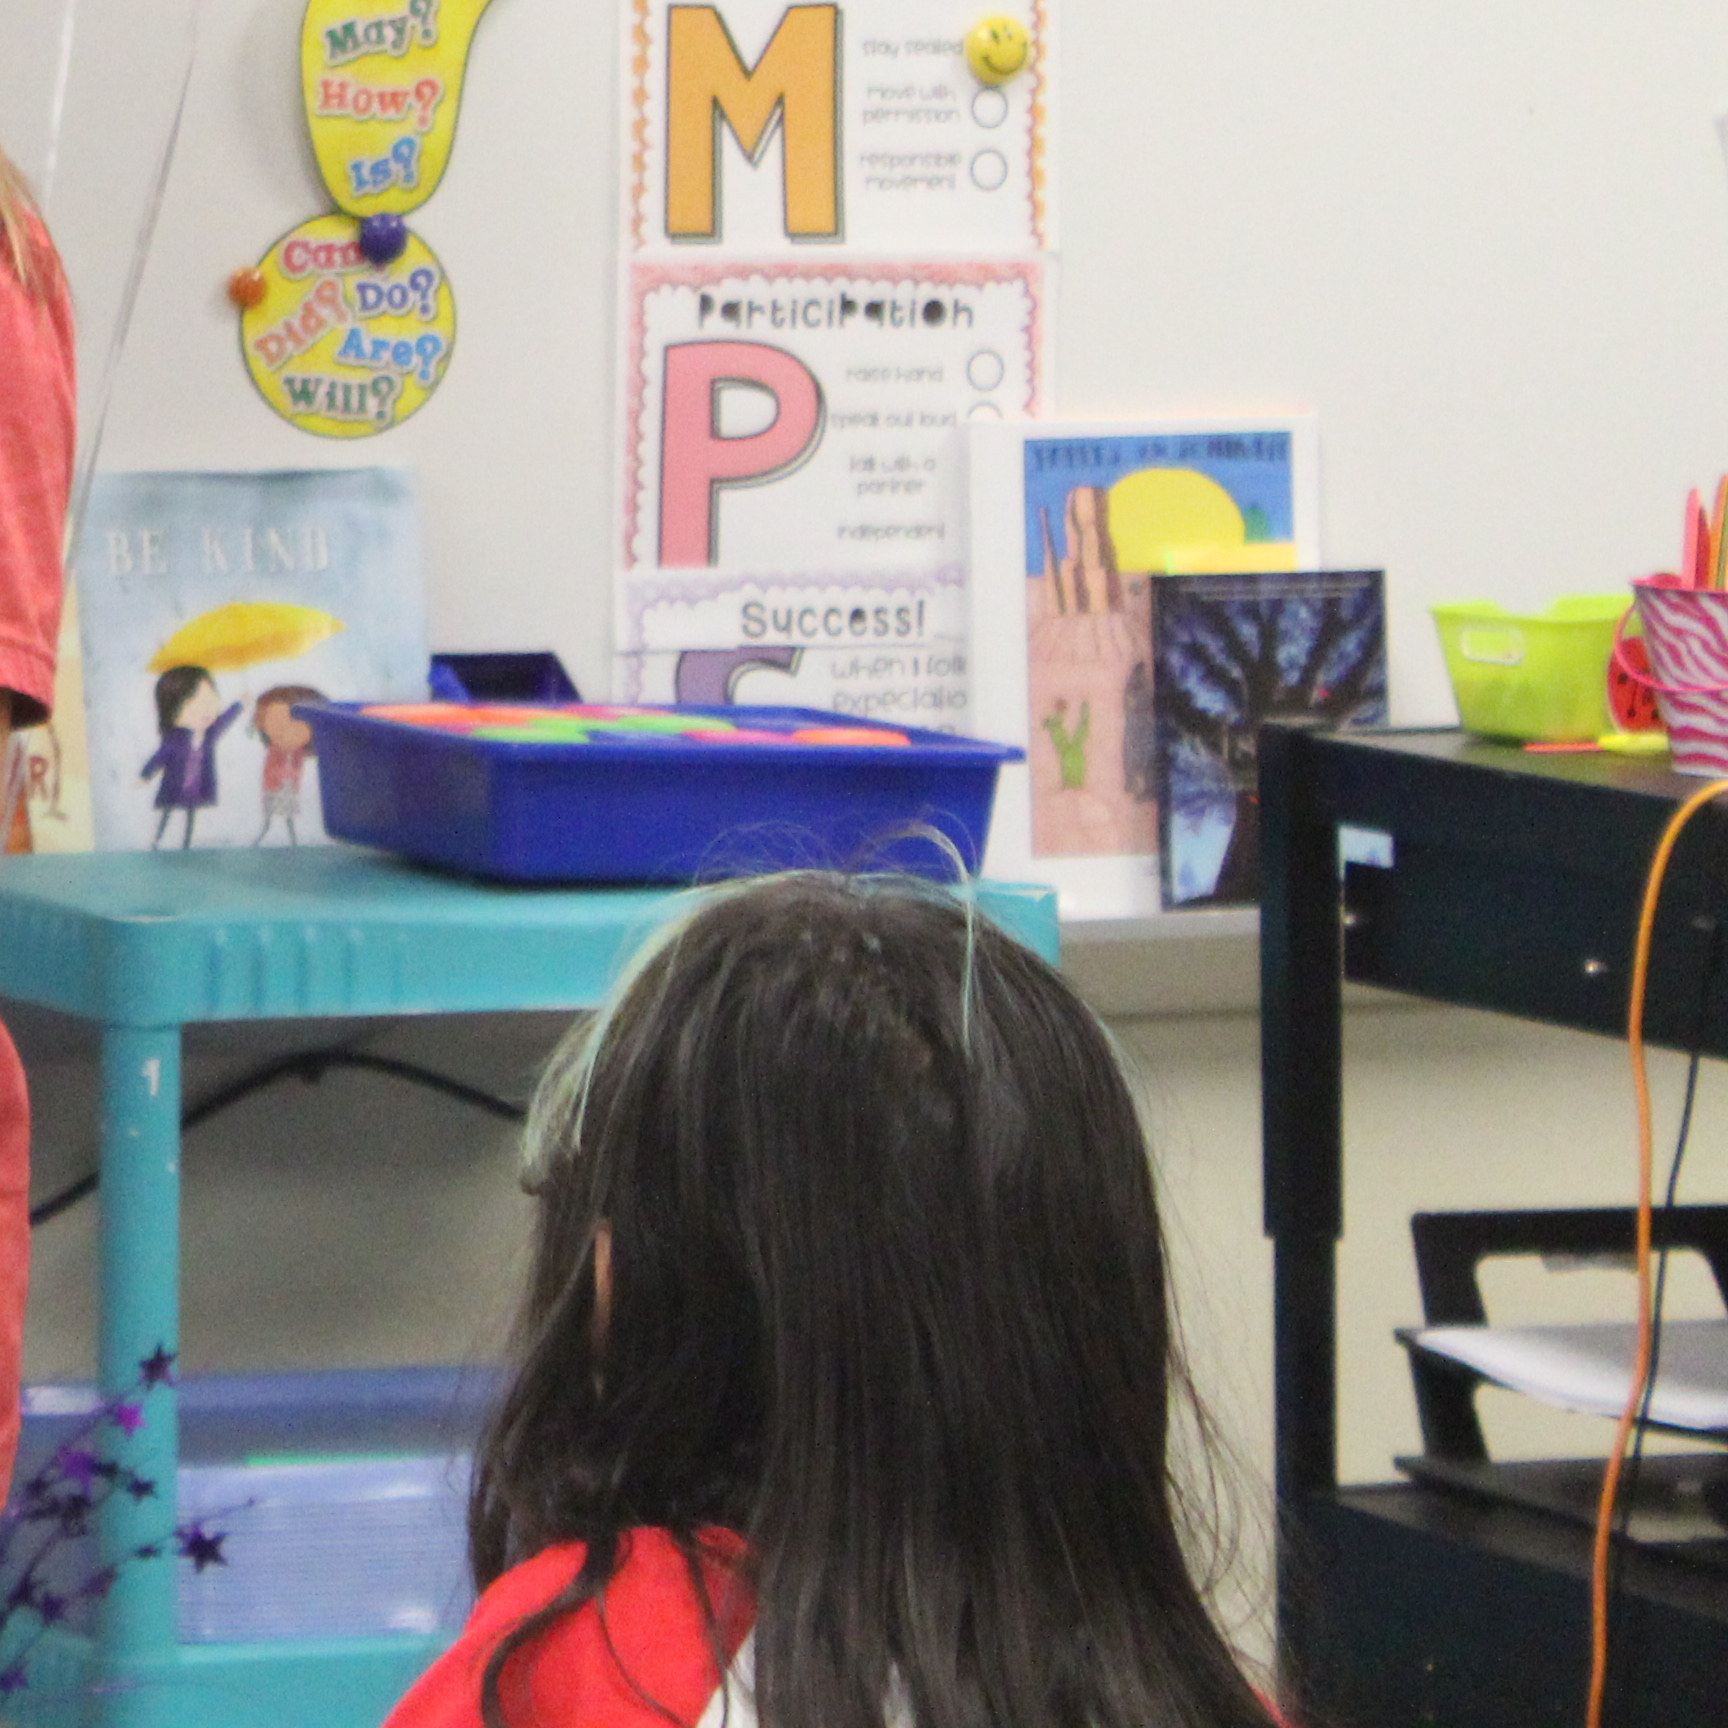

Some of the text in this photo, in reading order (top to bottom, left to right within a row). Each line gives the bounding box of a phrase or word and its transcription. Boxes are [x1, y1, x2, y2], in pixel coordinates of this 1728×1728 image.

[317, 79, 440, 128] How?
[665, 2, 844, 246] M
[350, 137, 418, 194] Is?
[283, 240, 386, 273] Can
[356, 268, 435, 315] Do?
[698, 292, 975, 328] Participation
[337, 328, 443, 380] Are?
[282, 375, 396, 420] Will?
[657, 339, 826, 569] P
[105, 527, 330, 574] BE KIND
[742, 599, 926, 639] Success!
